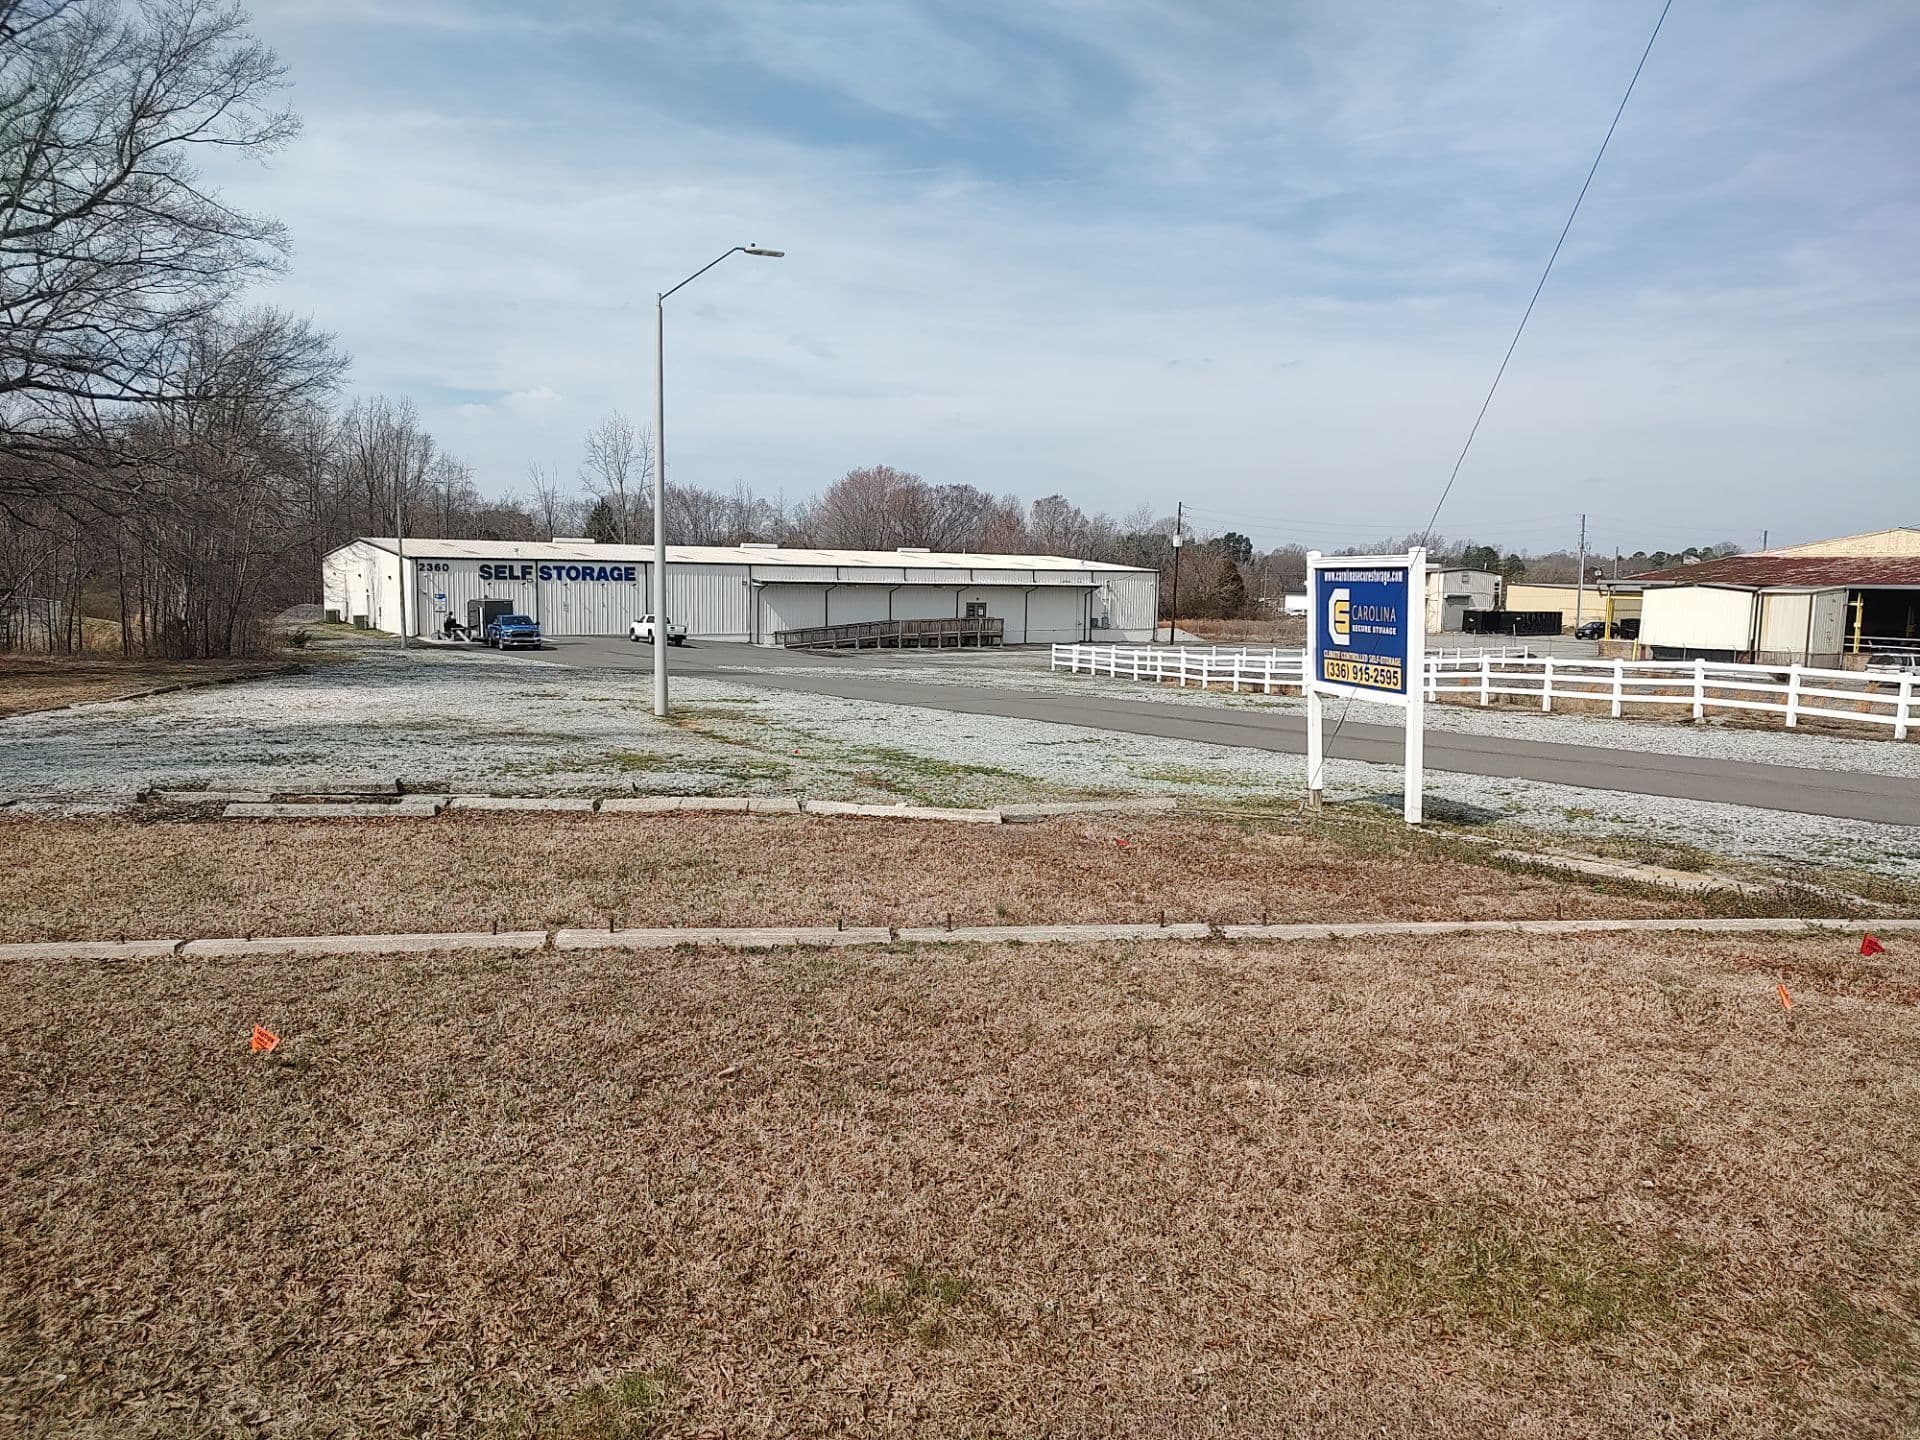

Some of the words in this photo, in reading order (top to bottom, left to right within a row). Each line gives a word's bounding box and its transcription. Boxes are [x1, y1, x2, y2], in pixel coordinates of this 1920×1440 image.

[419, 563, 450, 572] 2360
[479, 564, 534, 581] SELF
[538, 565, 637, 582] STORAGE
[1351, 605, 1396, 622] CAROLINA
[1326, 660, 1350, 681] (336)
[1352, 665, 1399, 686] 915-2595
